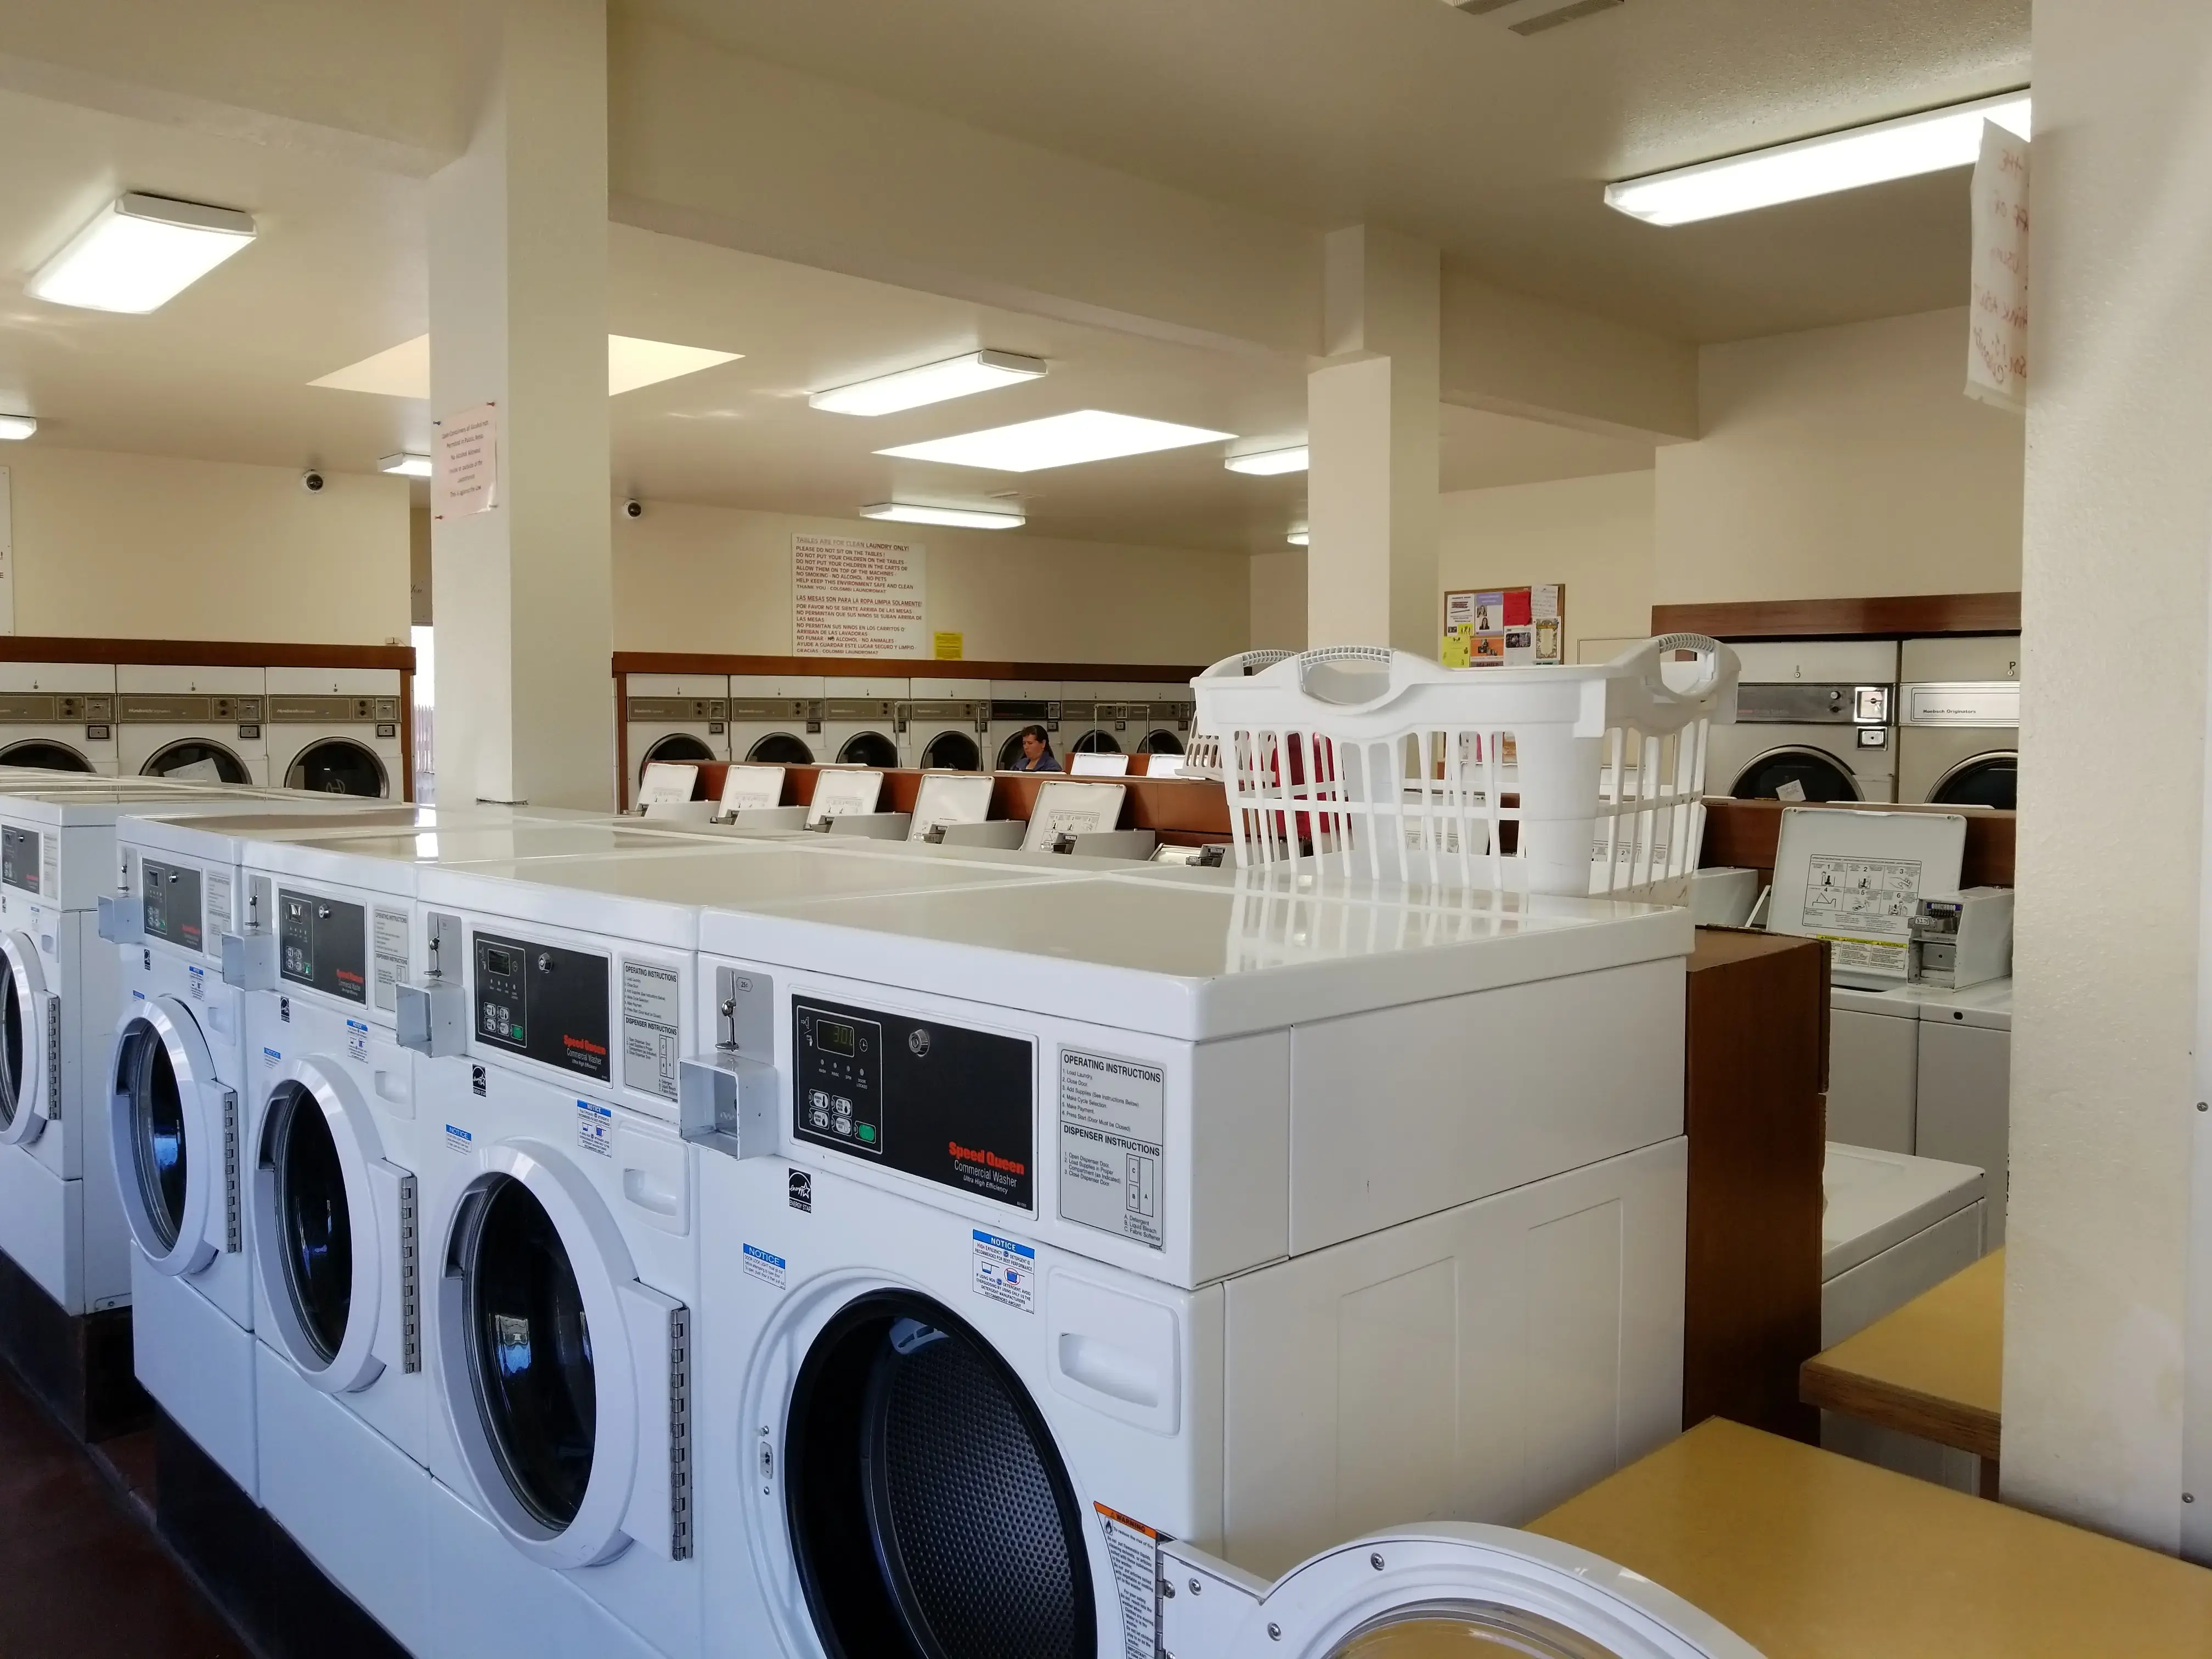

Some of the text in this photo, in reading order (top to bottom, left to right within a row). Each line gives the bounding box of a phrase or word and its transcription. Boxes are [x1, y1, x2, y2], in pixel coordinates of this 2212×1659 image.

[2009, 661, 2016, 669] P
[625, 966, 676, 982] OPERATING INSTRUCTIONS
[626, 1017, 676, 1035] DISPENSER INSTRUCTIONS
[567, 1048, 601, 1065] Commercial Washer
[1064, 1054, 1161, 1083] OPERATING INSTRUCTIONS
[1075, 1088, 1091, 1097] Supplies
[1102, 1094, 1124, 1104] Instructions
[587, 1103, 601, 1113] NOTICE
[1064, 1125, 1160, 1156] DISPENSER INSTRUCTIONS
[949, 1141, 1024, 1176] Speed Queen
[1079, 1161, 1095, 1170] Supplies
[1080, 1156, 1099, 1165] Dispenser
[955, 1160, 1017, 1187] Commercial Washer
[1069, 1165, 1094, 1175] Compartment
[1080, 1173, 1099, 1183] Dispenser
[963, 1175, 1008, 1194] Ultra High Efficiency
[789, 1200, 802, 1209] ENERGY
[991, 1237, 1016, 1251] NOTICE
[749, 1247, 780, 1266] NOTICE
[975, 1248, 996, 1259] RECOMMENDED
[1011, 1260, 1032, 1272] PERFORMANCE
[986, 1245, 1002, 1255] EFFICIENCY
[1010, 1254, 1026, 1263] DETERGENT
[1116, 1514, 1145, 1533] WARNING
